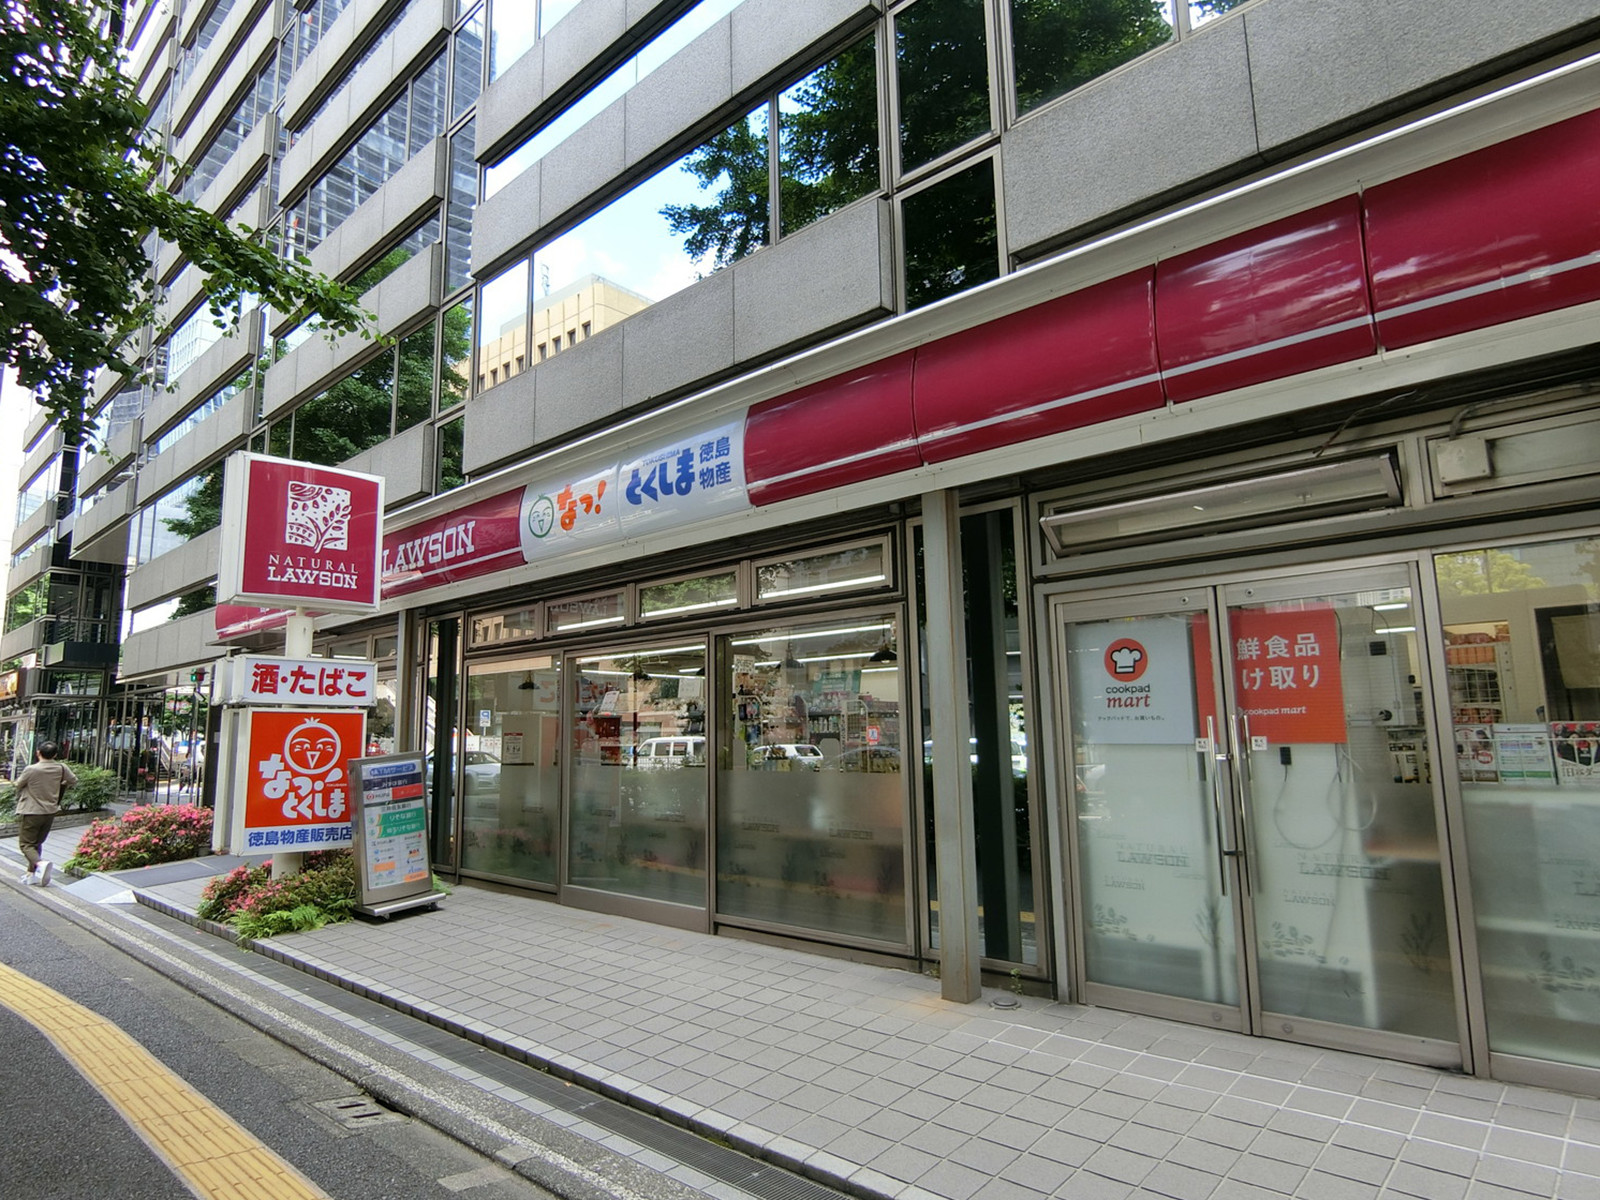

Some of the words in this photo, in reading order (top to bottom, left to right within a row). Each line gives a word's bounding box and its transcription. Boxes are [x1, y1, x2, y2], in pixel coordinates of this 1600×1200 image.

[700, 436, 731, 465] 徳島
[625, 447, 696, 506] とくしま
[700, 461, 731, 490] 物産
[382, 520, 475, 576] LAWSON
[267, 566, 358, 589] LAWSON
[268, 554, 359, 574] NATURAL
[1236, 632, 1320, 660] 鮮食品
[251, 663, 367, 697] 酒・たばこ
[1105, 684, 1150, 695] cookpad
[1242, 664, 1320, 691] け取り
[1107, 694, 1150, 709] mart
[1244, 707, 1279, 716] cookpad
[1281, 706, 1306, 715] mart
[282, 788, 345, 820] とくしま
[248, 826, 352, 848] 徳島物産販売店
